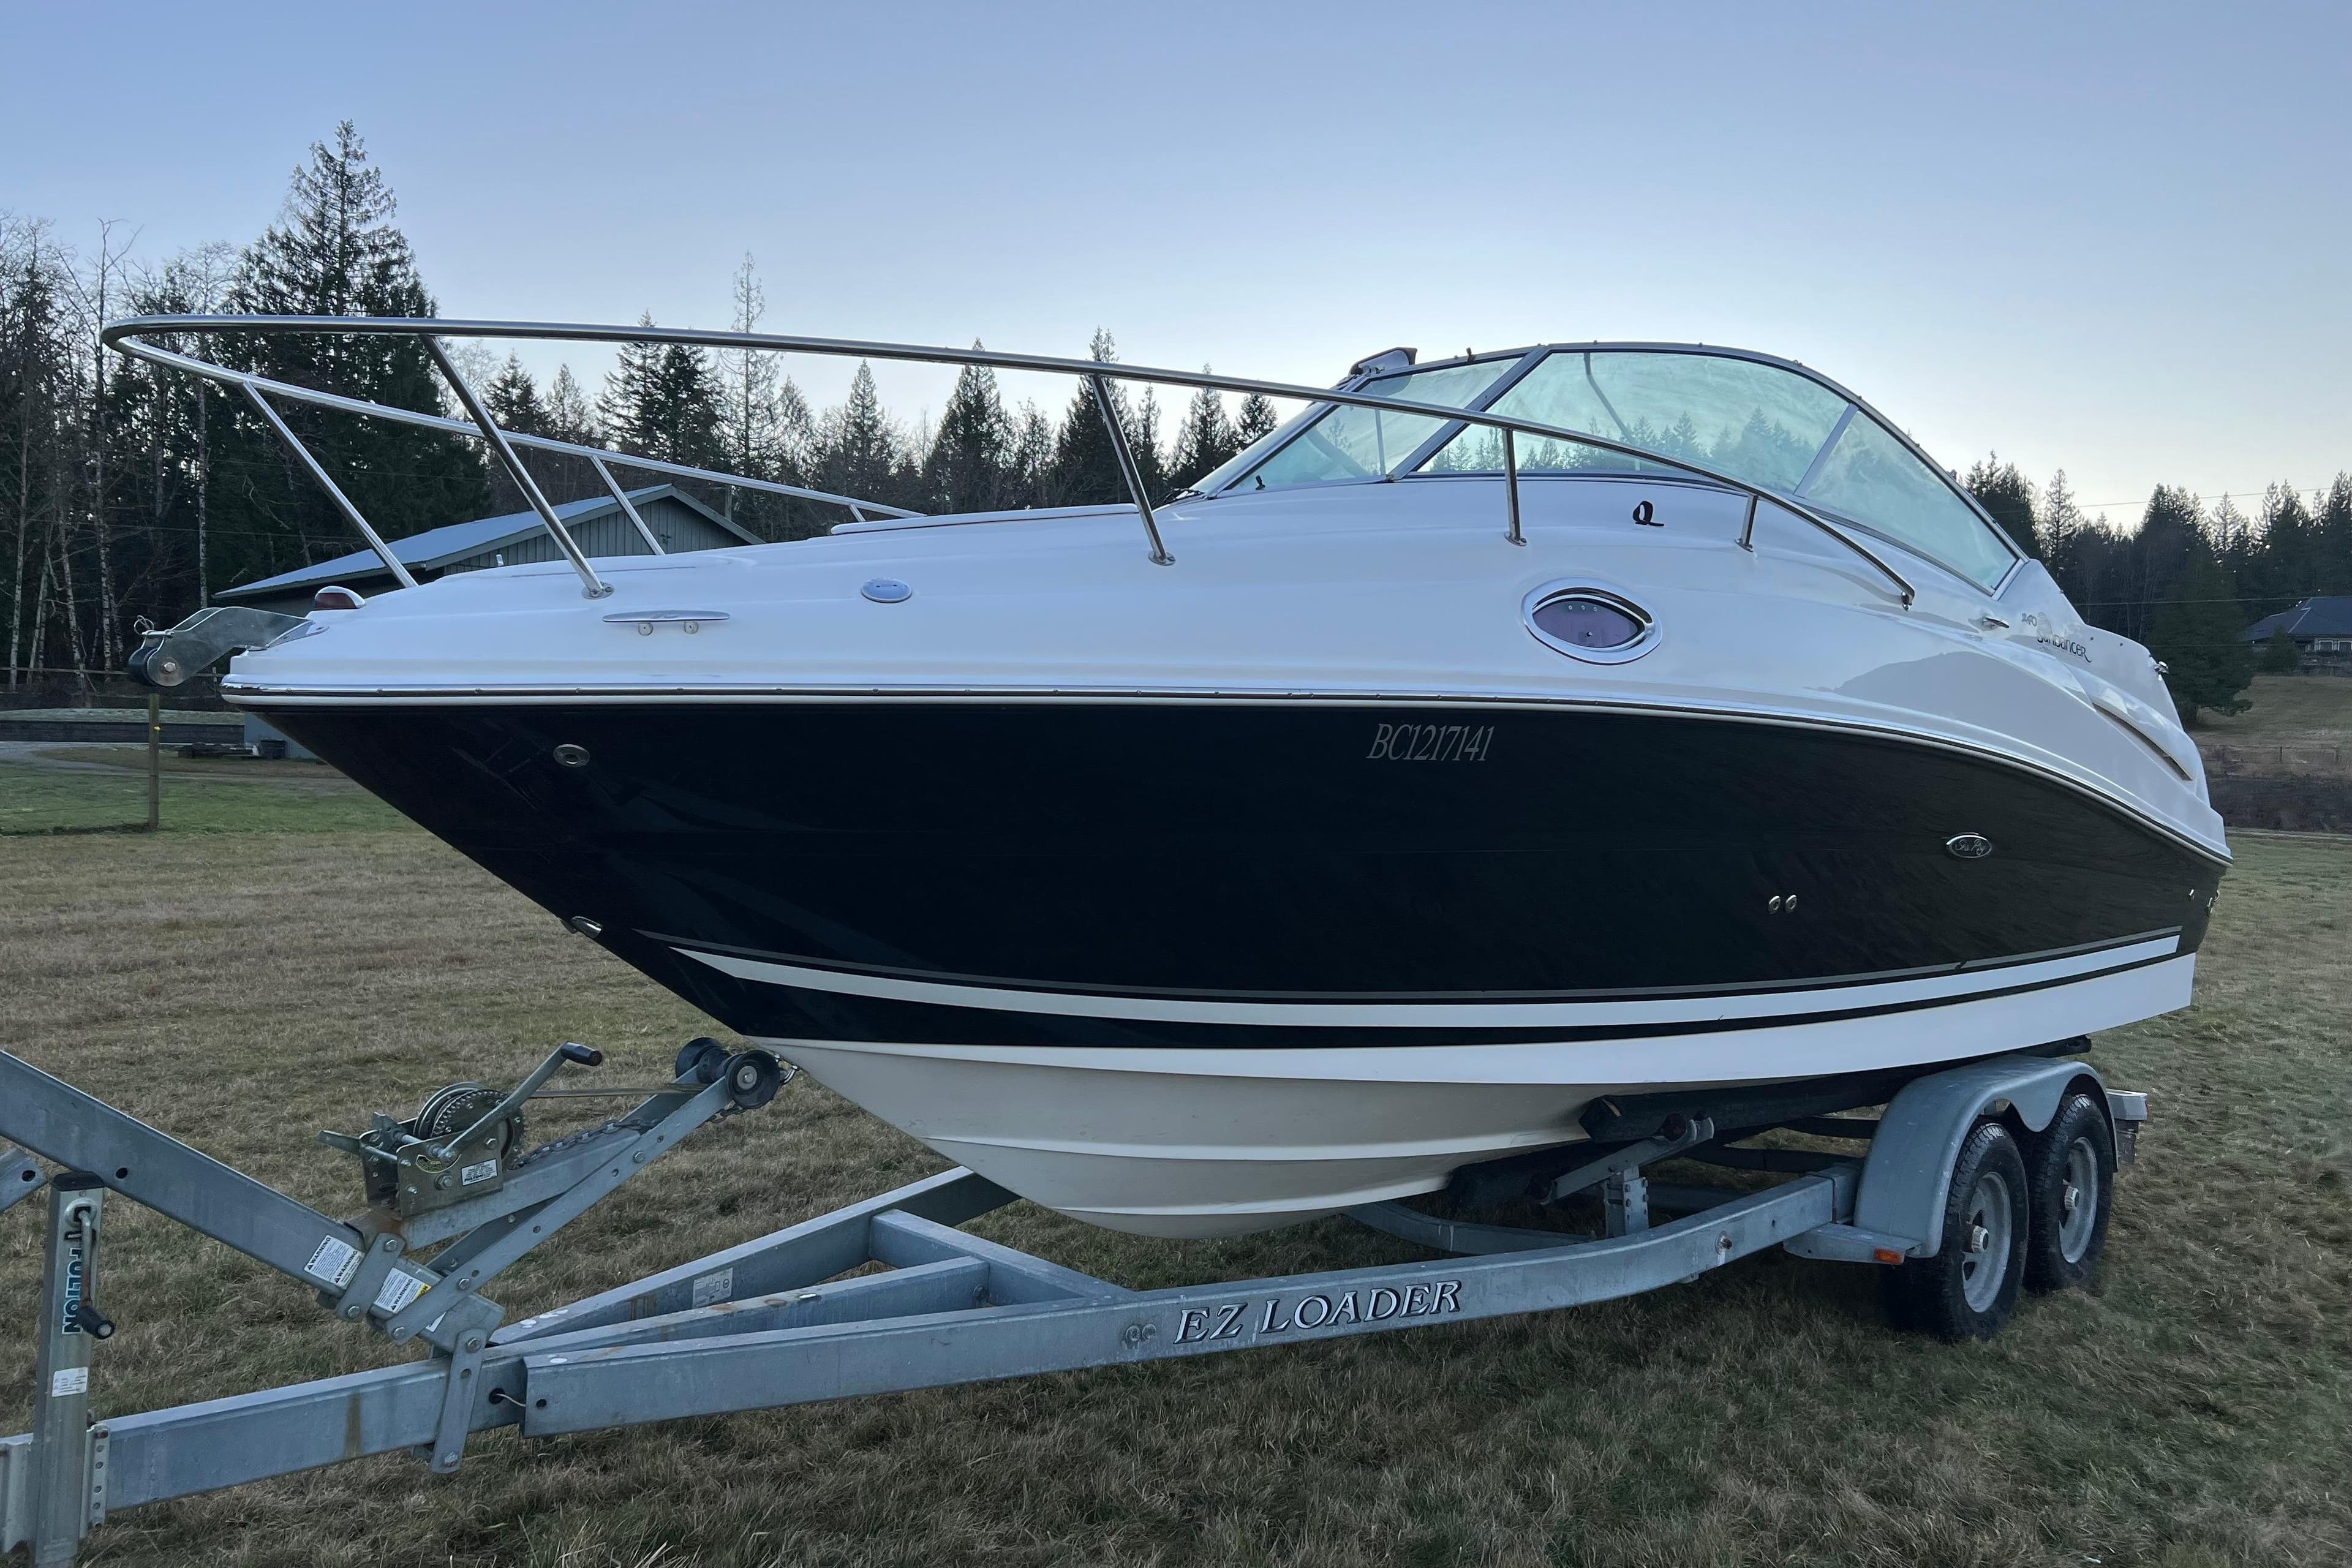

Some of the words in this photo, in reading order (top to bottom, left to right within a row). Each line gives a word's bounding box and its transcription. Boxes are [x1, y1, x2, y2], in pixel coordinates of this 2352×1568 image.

[2022, 613, 2037, 627] 240
[1365, 723, 1494, 761] BC1217141
[310, 1237, 331, 1264] WARNING
[337, 1250, 358, 1276] WARNING
[394, 1278, 413, 1304] WARNING
[1174, 1302, 1248, 1344] EZ
[1259, 1280, 1462, 1334] LOADER
